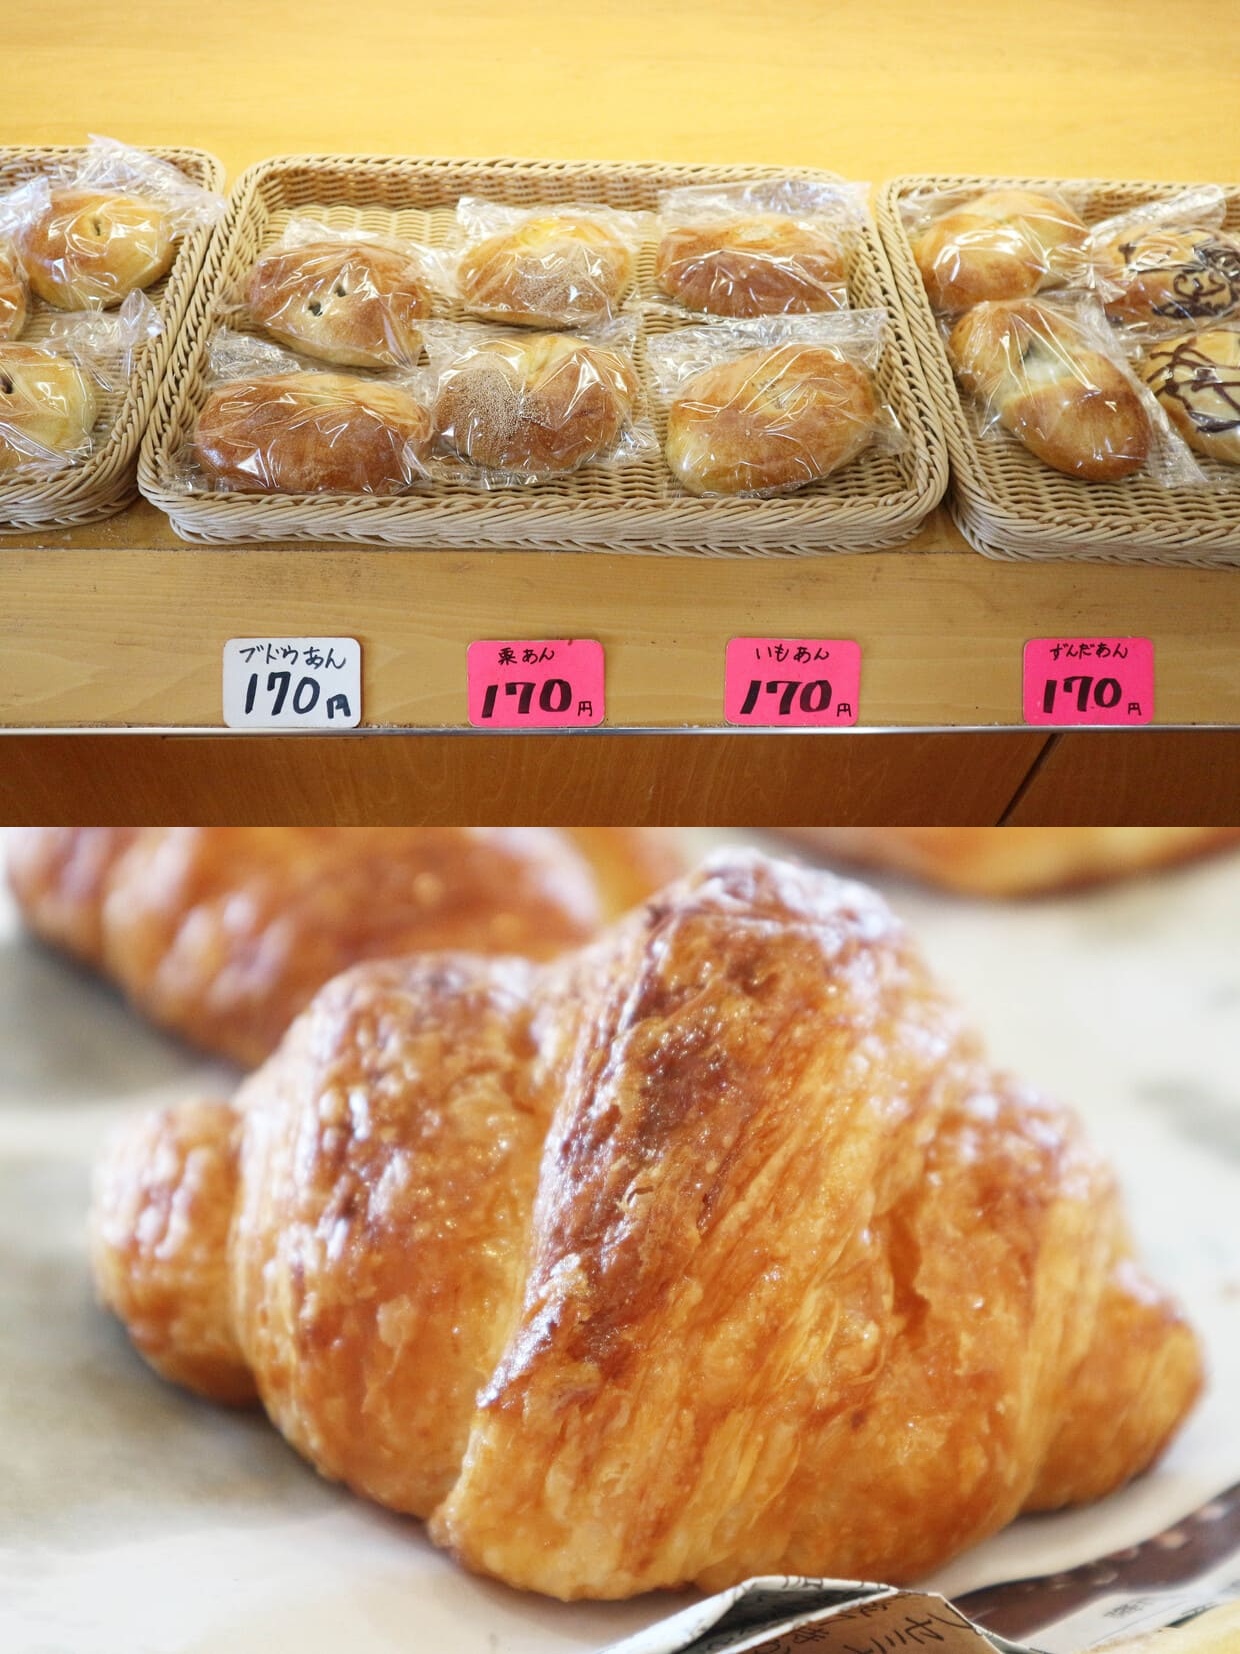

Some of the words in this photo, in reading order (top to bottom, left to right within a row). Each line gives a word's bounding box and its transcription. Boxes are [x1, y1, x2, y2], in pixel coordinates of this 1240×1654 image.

[240, 643, 347, 670] ブドウあん
[756, 644, 830, 664] いもあん
[1050, 642, 1129, 661] ずんだあん
